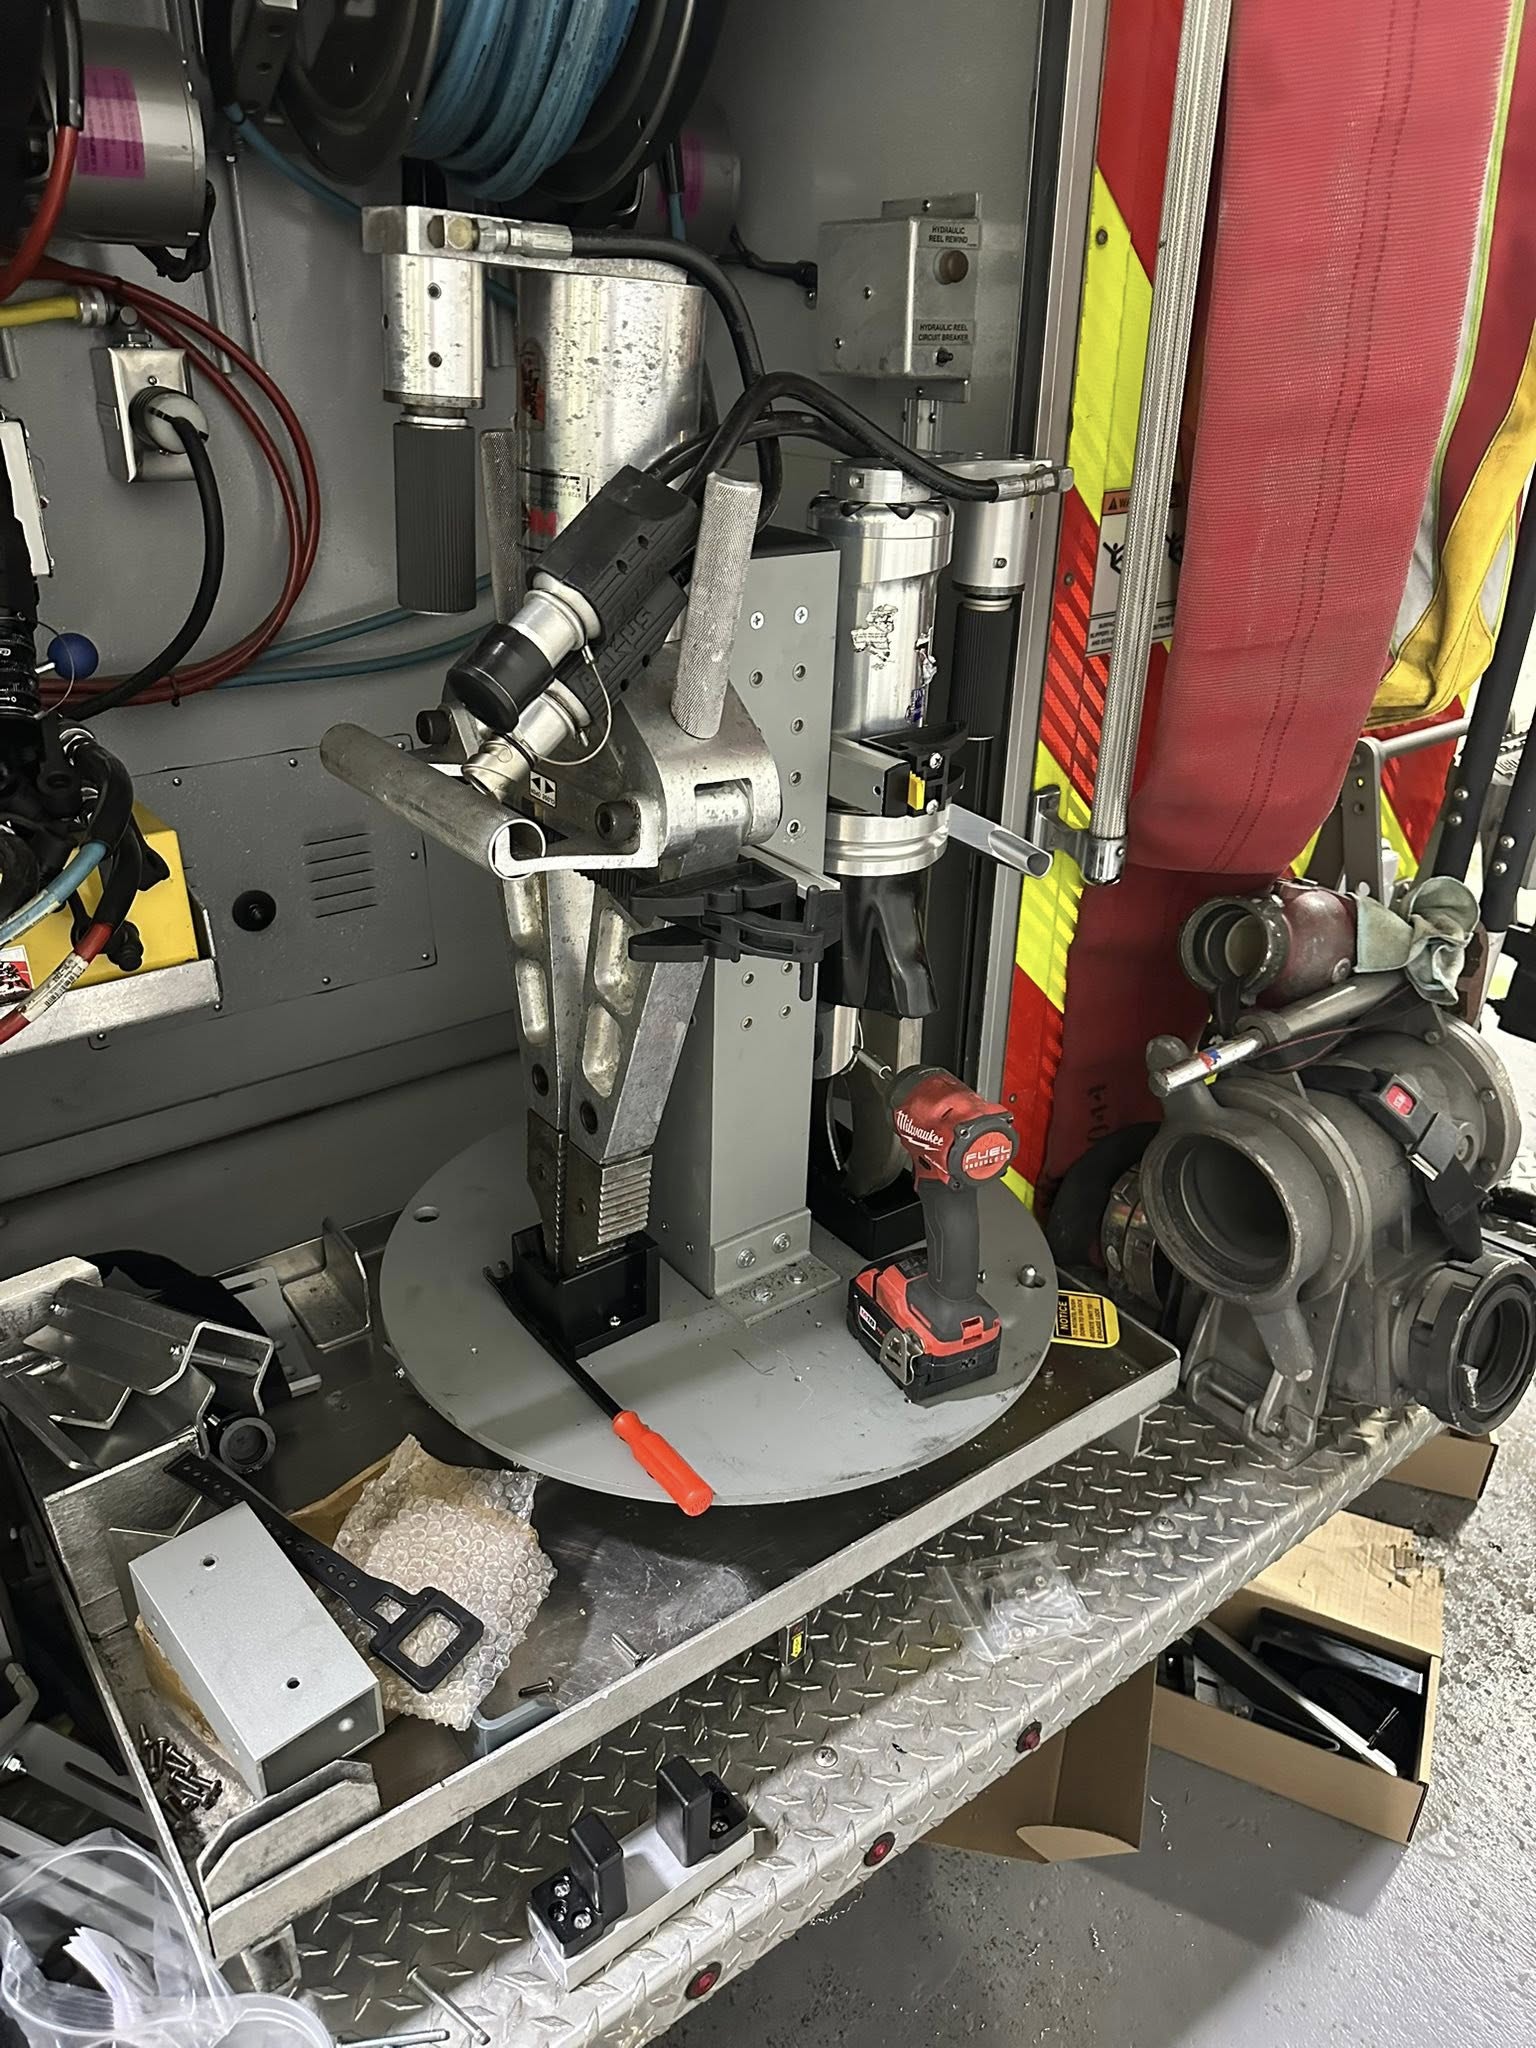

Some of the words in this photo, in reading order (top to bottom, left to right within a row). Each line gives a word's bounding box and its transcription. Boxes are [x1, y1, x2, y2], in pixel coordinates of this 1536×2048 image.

[931, 226, 966, 234] HYDRAULIC
[928, 234, 944, 243] REEL
[945, 235, 969, 243] REWIND
[920, 323, 952, 332] HYDRAULIC
[953, 323, 968, 332] REEL
[918, 333, 941, 342] CIRCUIT
[942, 333, 969, 342] BREAKER
[896, 1110, 944, 1146] Milwaukee
[965, 1145, 1011, 1163] FUEL
[1059, 1301, 1069, 1330] NOTICE
